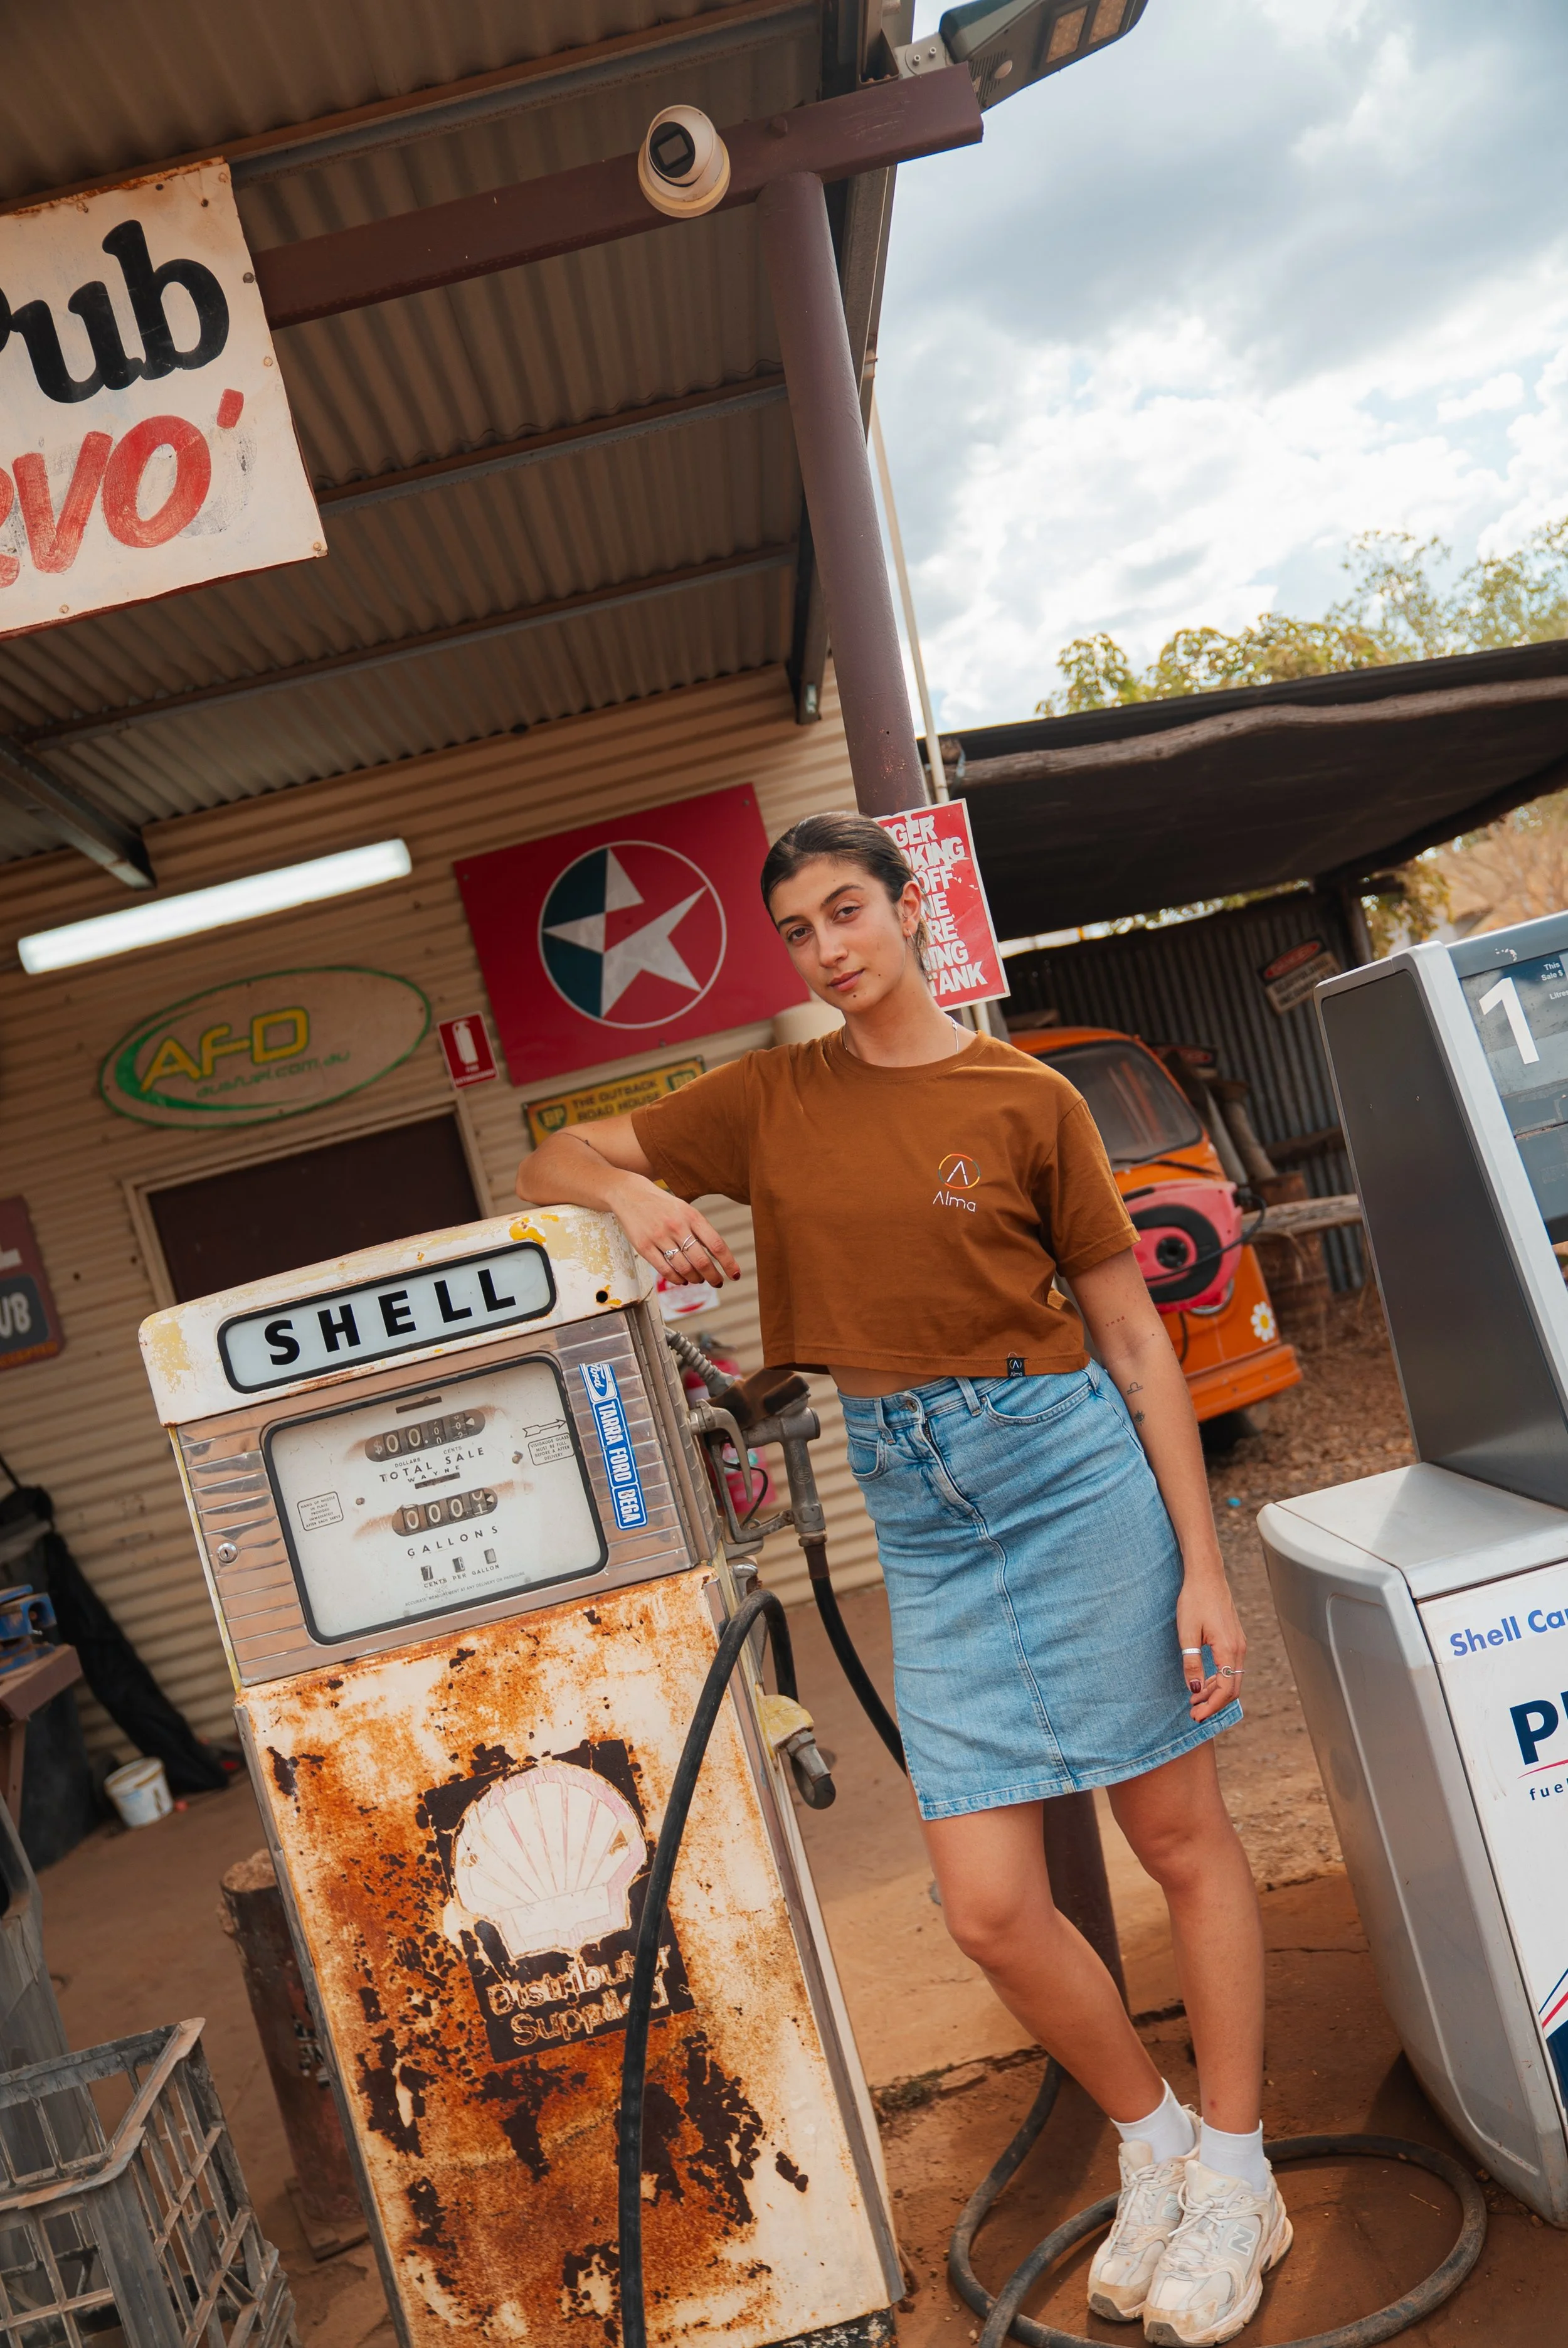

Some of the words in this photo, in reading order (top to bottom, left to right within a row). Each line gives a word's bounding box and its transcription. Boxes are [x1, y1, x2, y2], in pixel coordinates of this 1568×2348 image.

[0, 220, 230, 403] ub
[884, 815, 938, 847] GER
[928, 961, 988, 996] TANK
[1541, 972, 1557, 981] Sale
[1544, 962, 1560, 970] This
[1479, 977, 1540, 1065] 1
[933, 1191, 976, 1212] Alma
[264, 1268, 516, 1366] SHELL
[598, 1401, 624, 1446] TARRA
[379, 1462, 433, 1482] TOTAL
[445, 1447, 484, 1465] SALE
[395, 1457, 421, 1468] DOLLARS
[443, 1446, 463, 1455] CENTS
[408, 1465, 460, 1483] WAYNE
[608, 1447, 632, 1482] FORD
[617, 1489, 642, 1524] BEGA
[408, 1526, 497, 1557] GALLONS
[424, 1578, 447, 1588] CENTS
[472, 1564, 499, 1575] GALLON
[1449, 1615, 1522, 1657] Shell
[1509, 1690, 1568, 1766] P
[485, 1945, 670, 2016] Distributr
